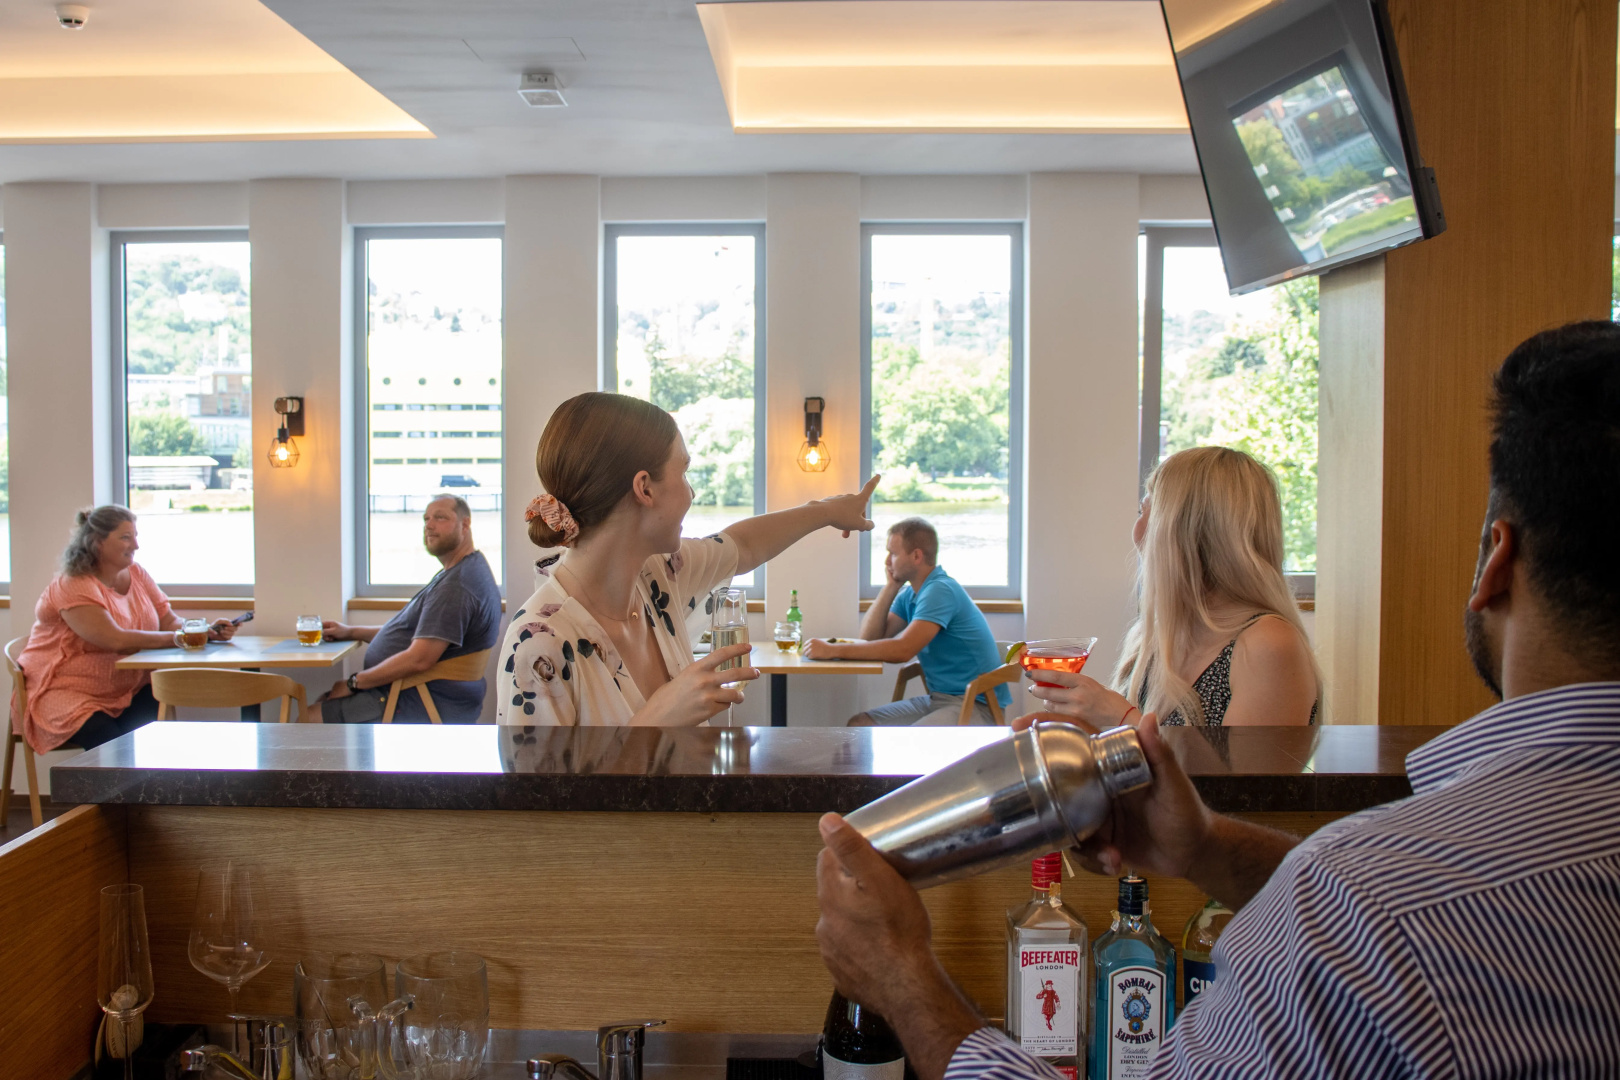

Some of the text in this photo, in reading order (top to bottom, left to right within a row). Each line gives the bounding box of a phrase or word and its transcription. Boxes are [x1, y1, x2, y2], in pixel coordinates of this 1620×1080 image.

[1021, 950, 1078, 968] BEEFEATER
[1117, 977, 1157, 995] BOMBAY
[1114, 1027, 1157, 1045] SAPPHIRE
